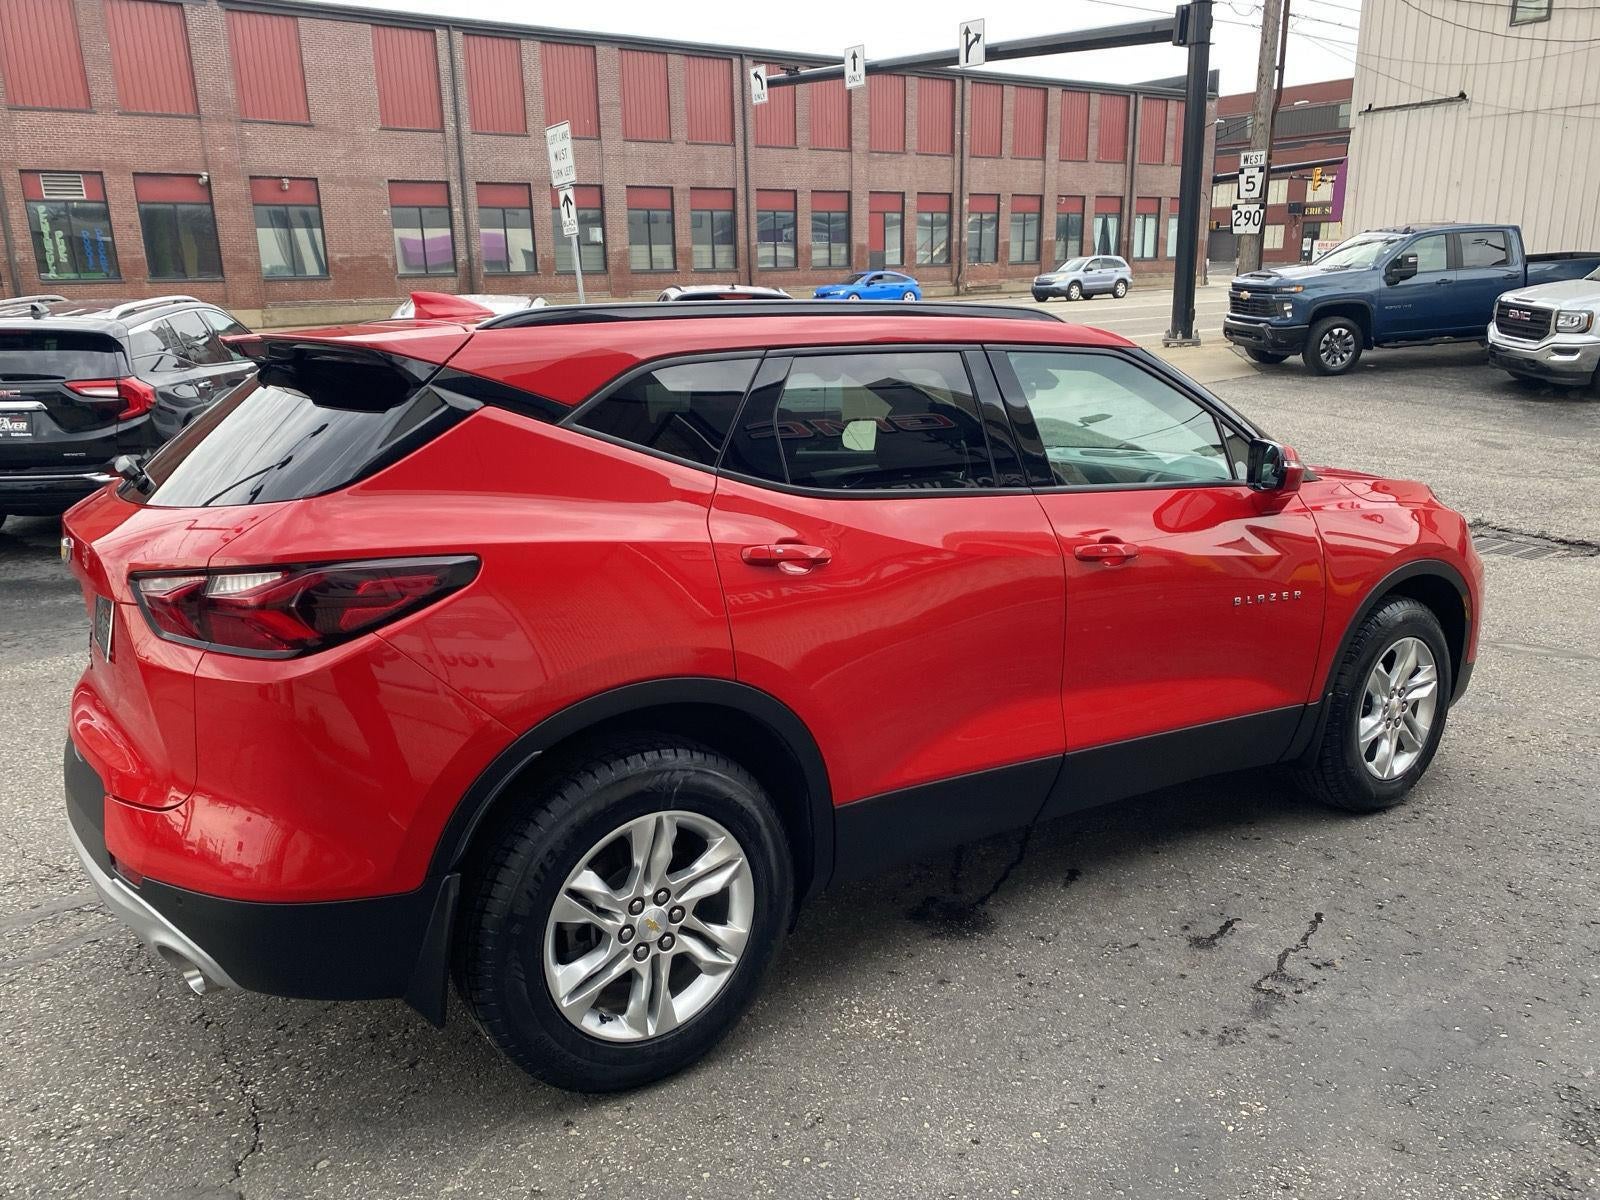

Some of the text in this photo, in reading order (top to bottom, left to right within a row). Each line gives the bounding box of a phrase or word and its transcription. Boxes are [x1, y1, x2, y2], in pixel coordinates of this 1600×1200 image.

[848, 73, 862, 83] ONLY
[554, 148, 568, 161] MUST
[1243, 154, 1264, 164] WEST
[1245, 175, 1256, 192] 5
[1234, 210, 1261, 227] 290
[1508, 309, 1531, 321] GMC
[1233, 590, 1302, 606] BLAZER
